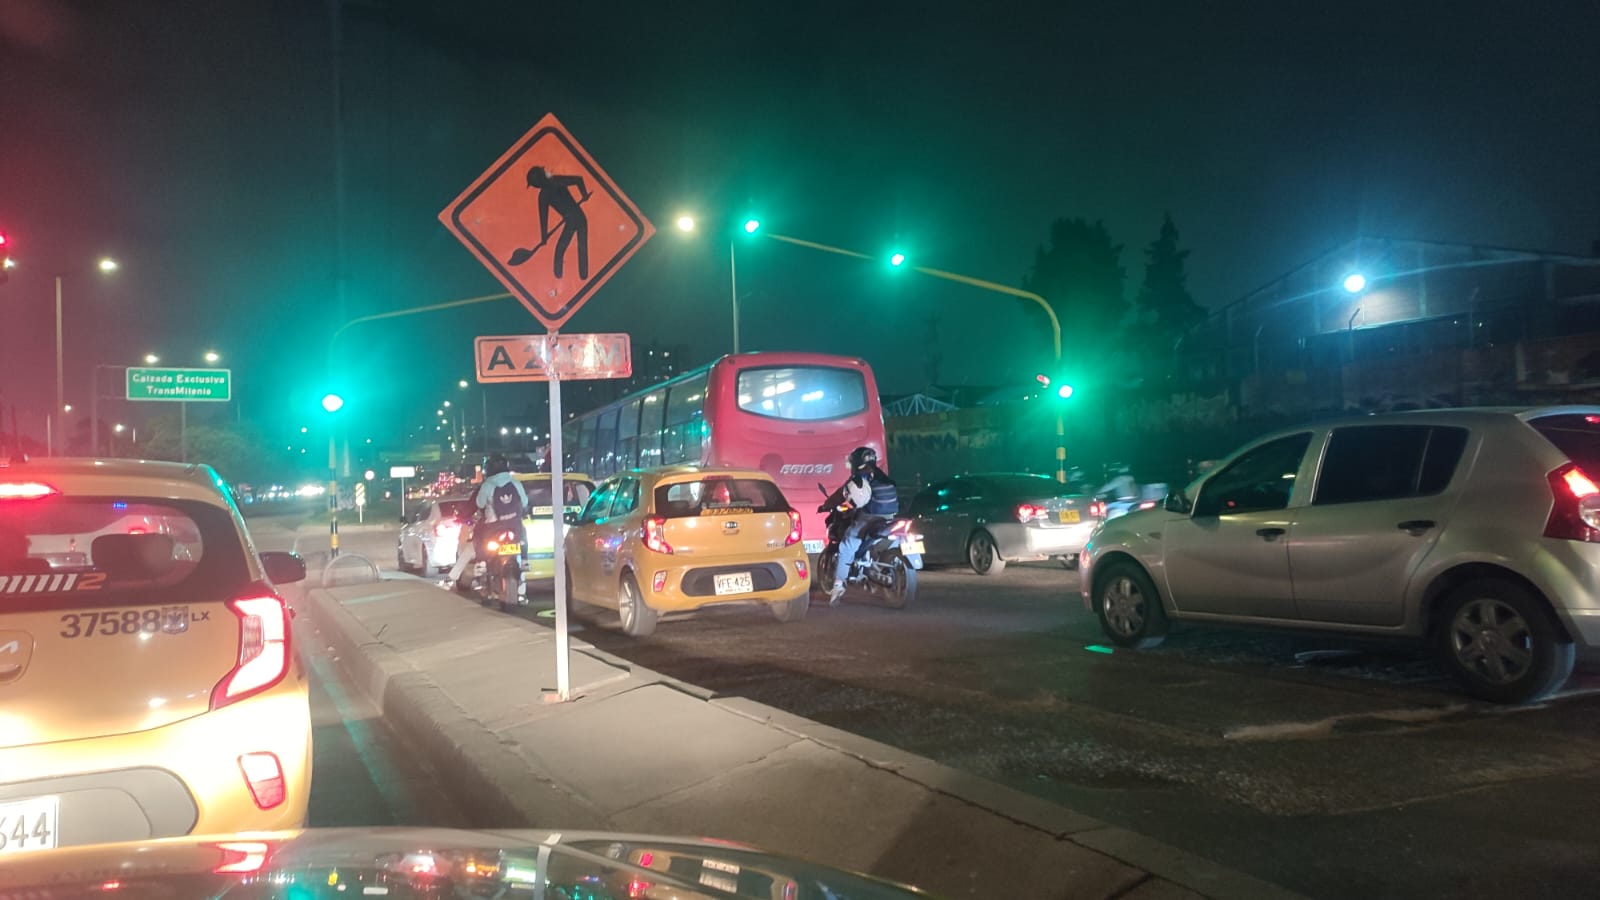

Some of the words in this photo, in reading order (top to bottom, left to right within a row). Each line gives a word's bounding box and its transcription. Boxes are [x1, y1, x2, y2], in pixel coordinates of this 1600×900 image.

[487, 344, 516, 371] A
[132, 373, 173, 384] Calzada
[146, 385, 212, 396] TransMilenio
[191, 611, 210, 622] LX
[60, 609, 160, 638] 37588
